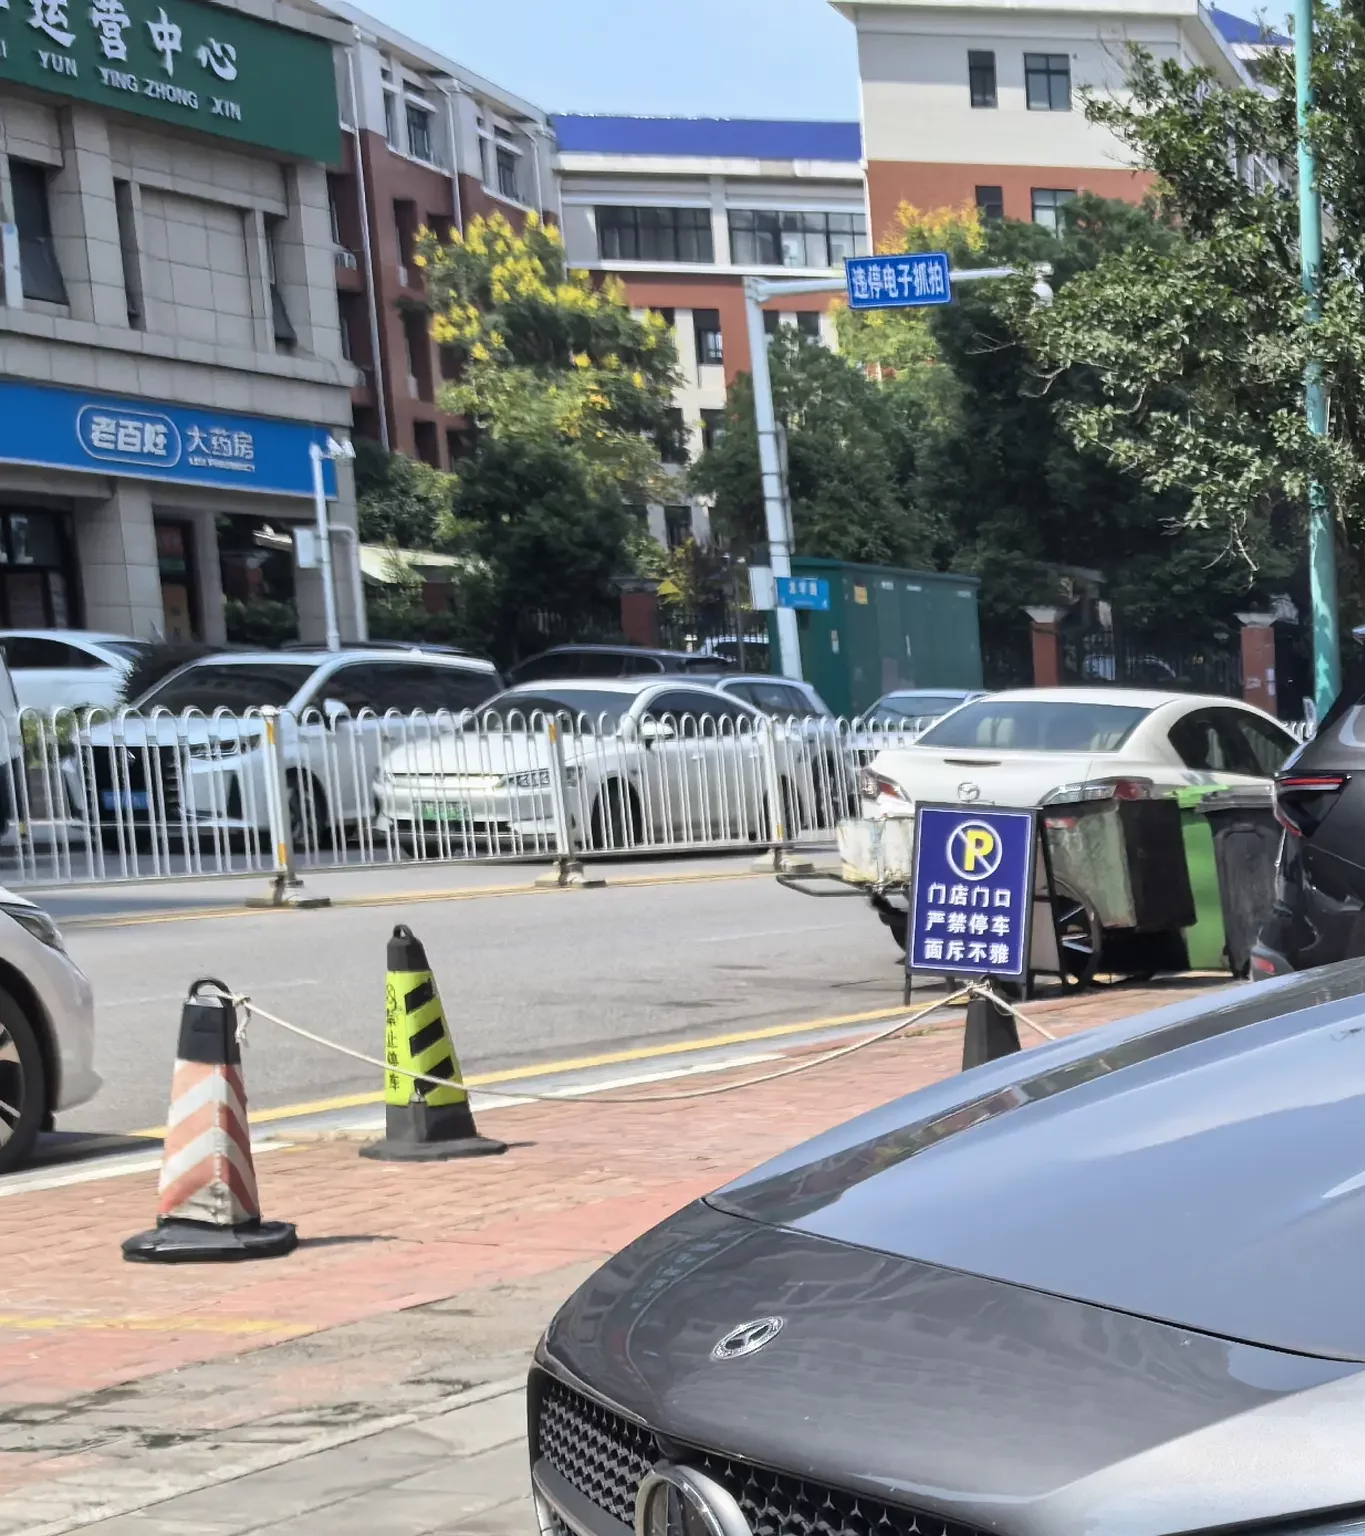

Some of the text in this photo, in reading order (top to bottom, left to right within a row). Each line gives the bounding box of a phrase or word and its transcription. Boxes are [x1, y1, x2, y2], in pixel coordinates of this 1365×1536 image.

[0, 0, 238, 81] 运营中心
[38, 50, 242, 121] YUN YING ZHONG XIN
[851, 260, 945, 299] 违停电子抓拍
[186, 424, 254, 460] 大药房
[927, 883, 1012, 908] 门店门口
[925, 911, 1011, 937] 严禁停车
[924, 939, 1010, 965] 面斥不雅
